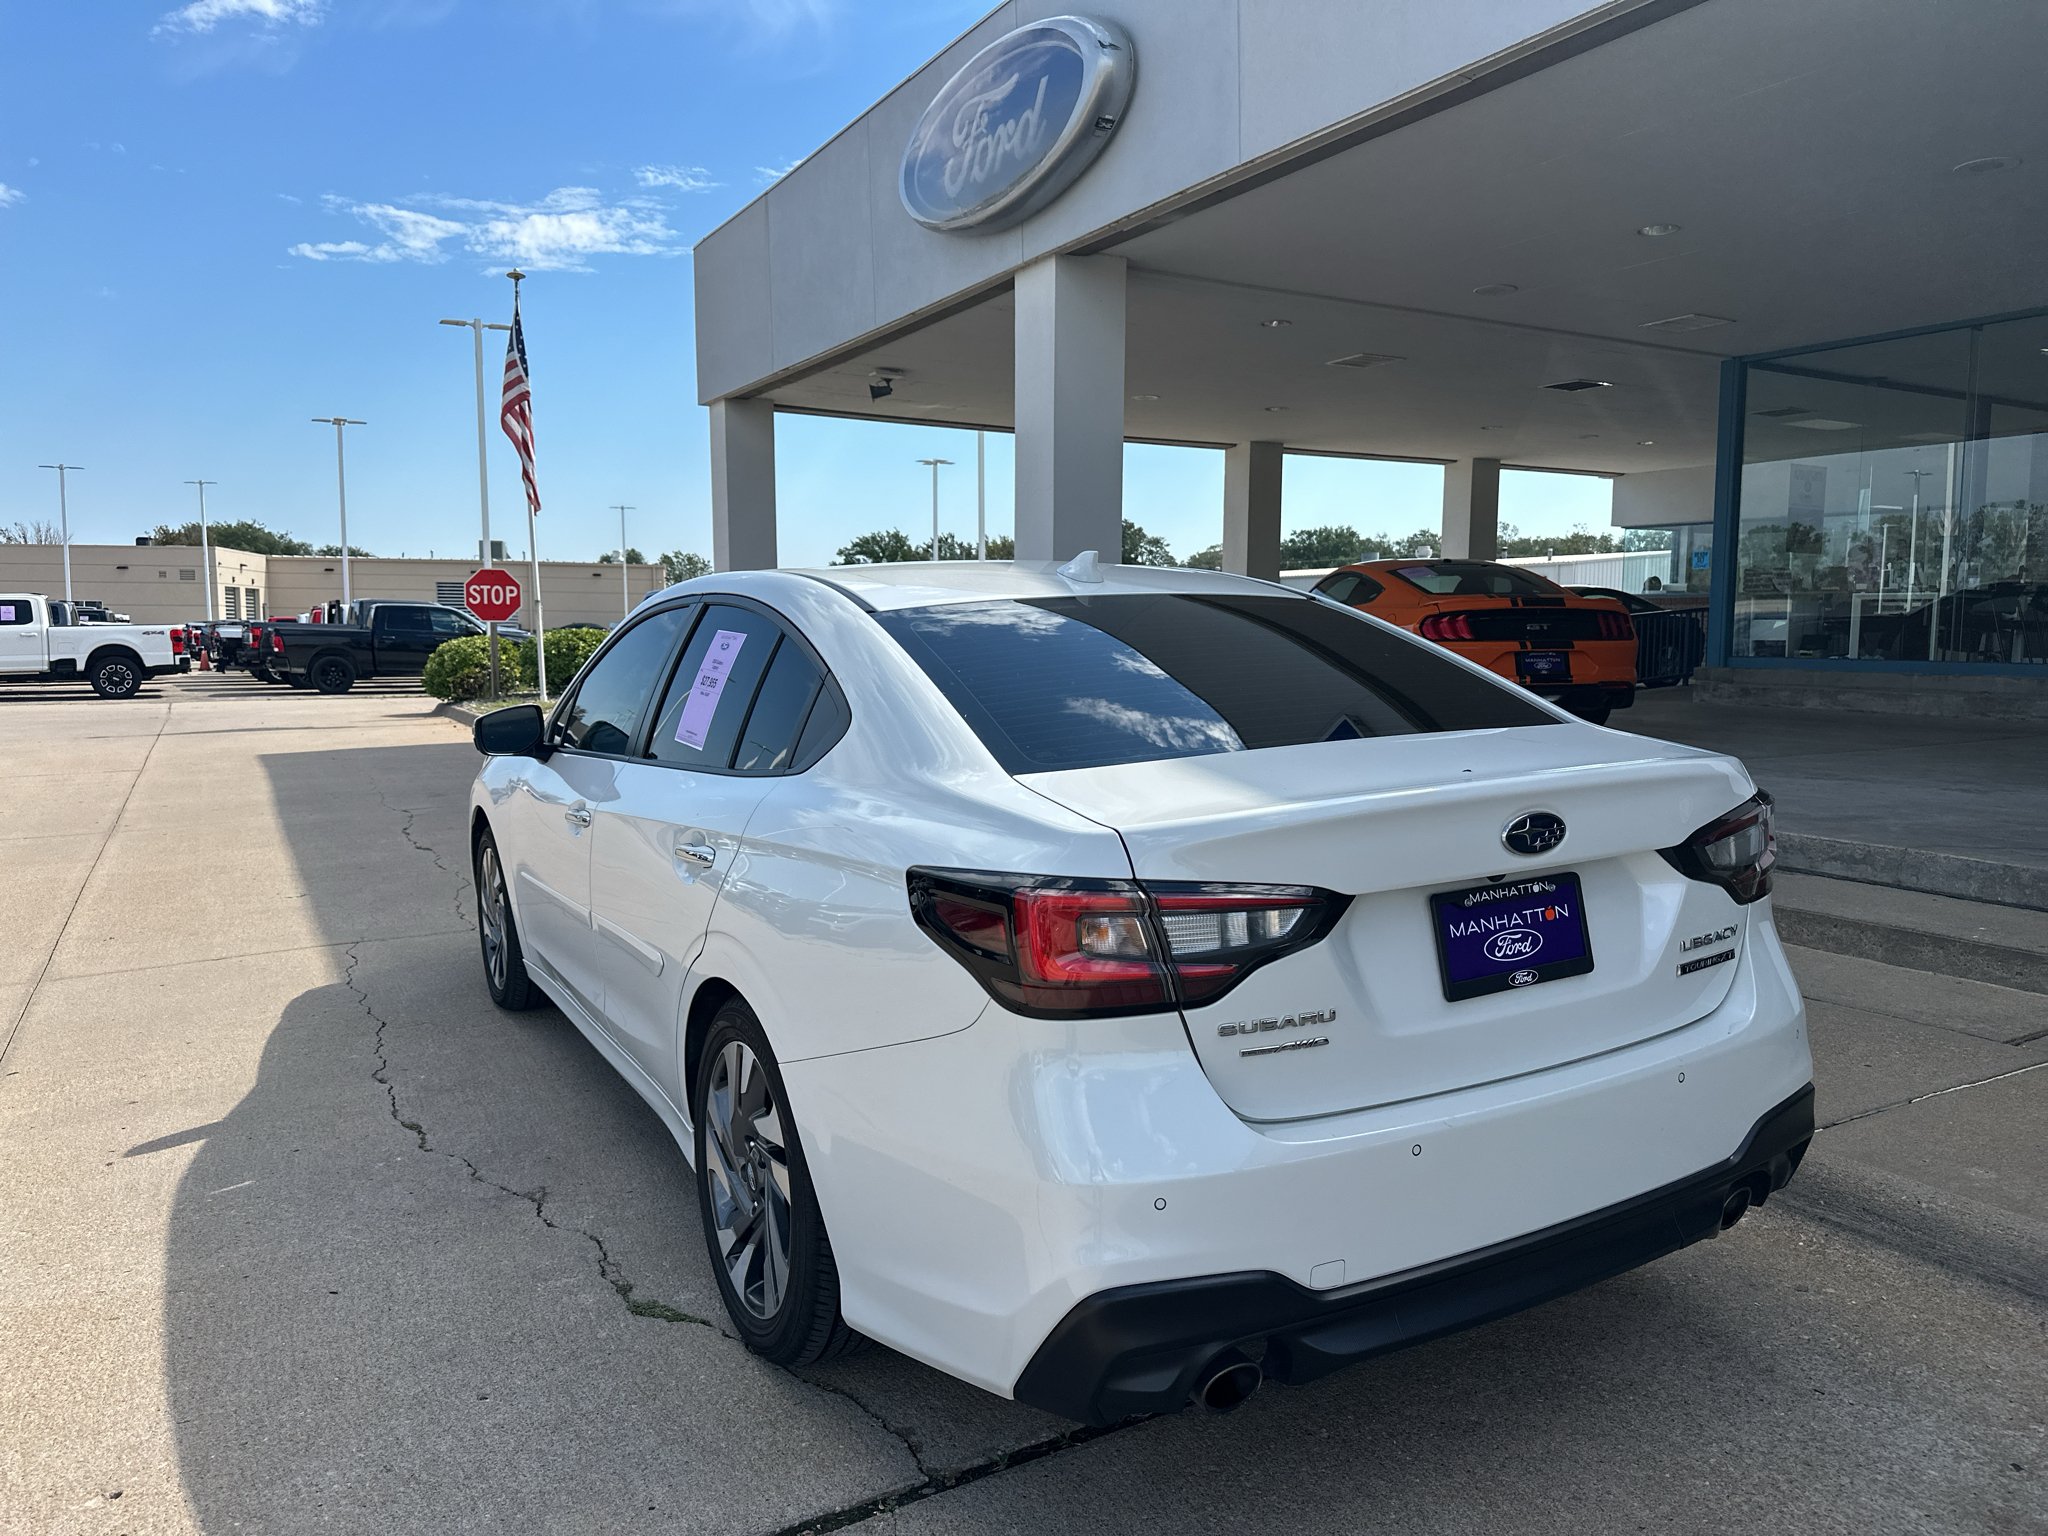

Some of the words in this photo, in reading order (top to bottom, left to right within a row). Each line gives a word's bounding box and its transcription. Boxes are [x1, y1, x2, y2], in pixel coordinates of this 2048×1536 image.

[944, 73, 1049, 199] Ford
[468, 585, 518, 605] STOP
[1494, 933, 1534, 957] Ford
[1680, 924, 1738, 952] LEGACY
[1514, 972, 1534, 984] Ford
[1217, 1008, 1337, 1037] SUBARU
